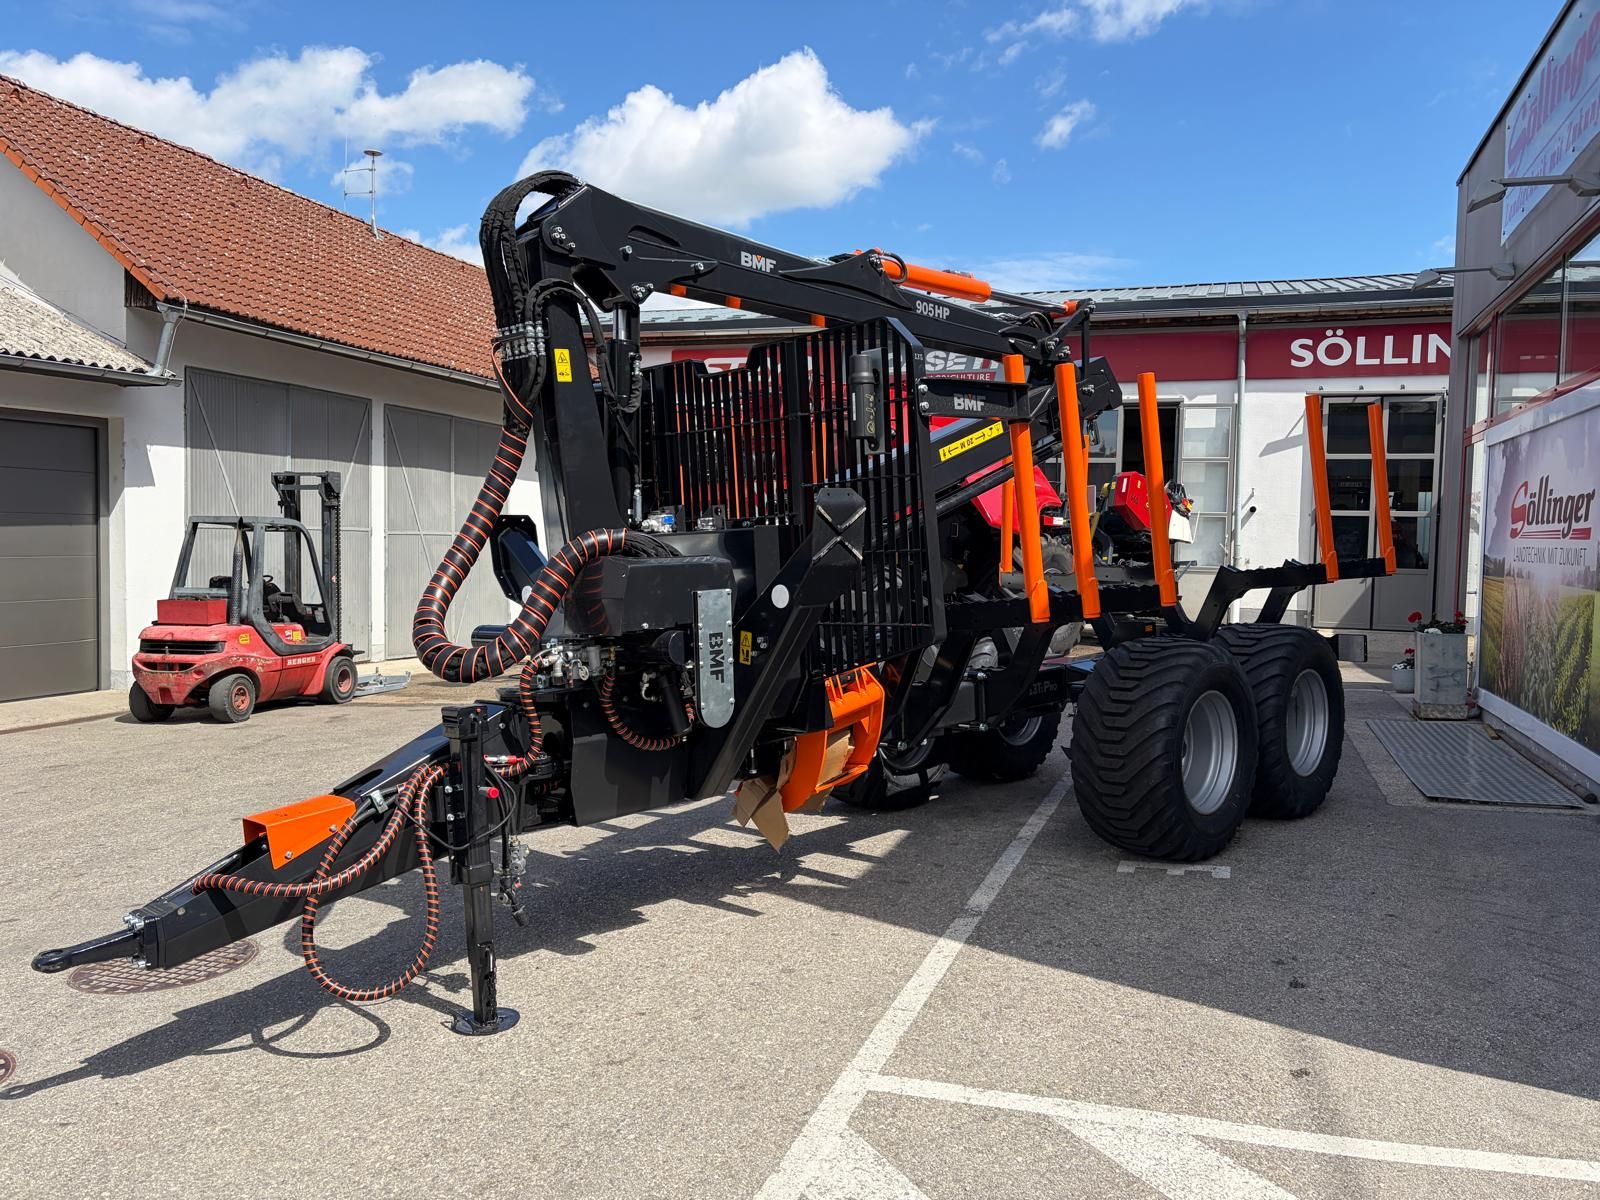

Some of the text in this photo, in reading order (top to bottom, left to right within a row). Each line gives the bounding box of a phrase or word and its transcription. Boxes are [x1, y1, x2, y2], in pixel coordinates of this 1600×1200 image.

[740, 250, 777, 273] BMF
[915, 300, 951, 320] 905HP
[1290, 328, 1451, 368] SÖLLIN
[953, 392, 986, 412] BMF
[1509, 474, 1596, 539] Söllinger
[708, 631, 725, 684] BMF
